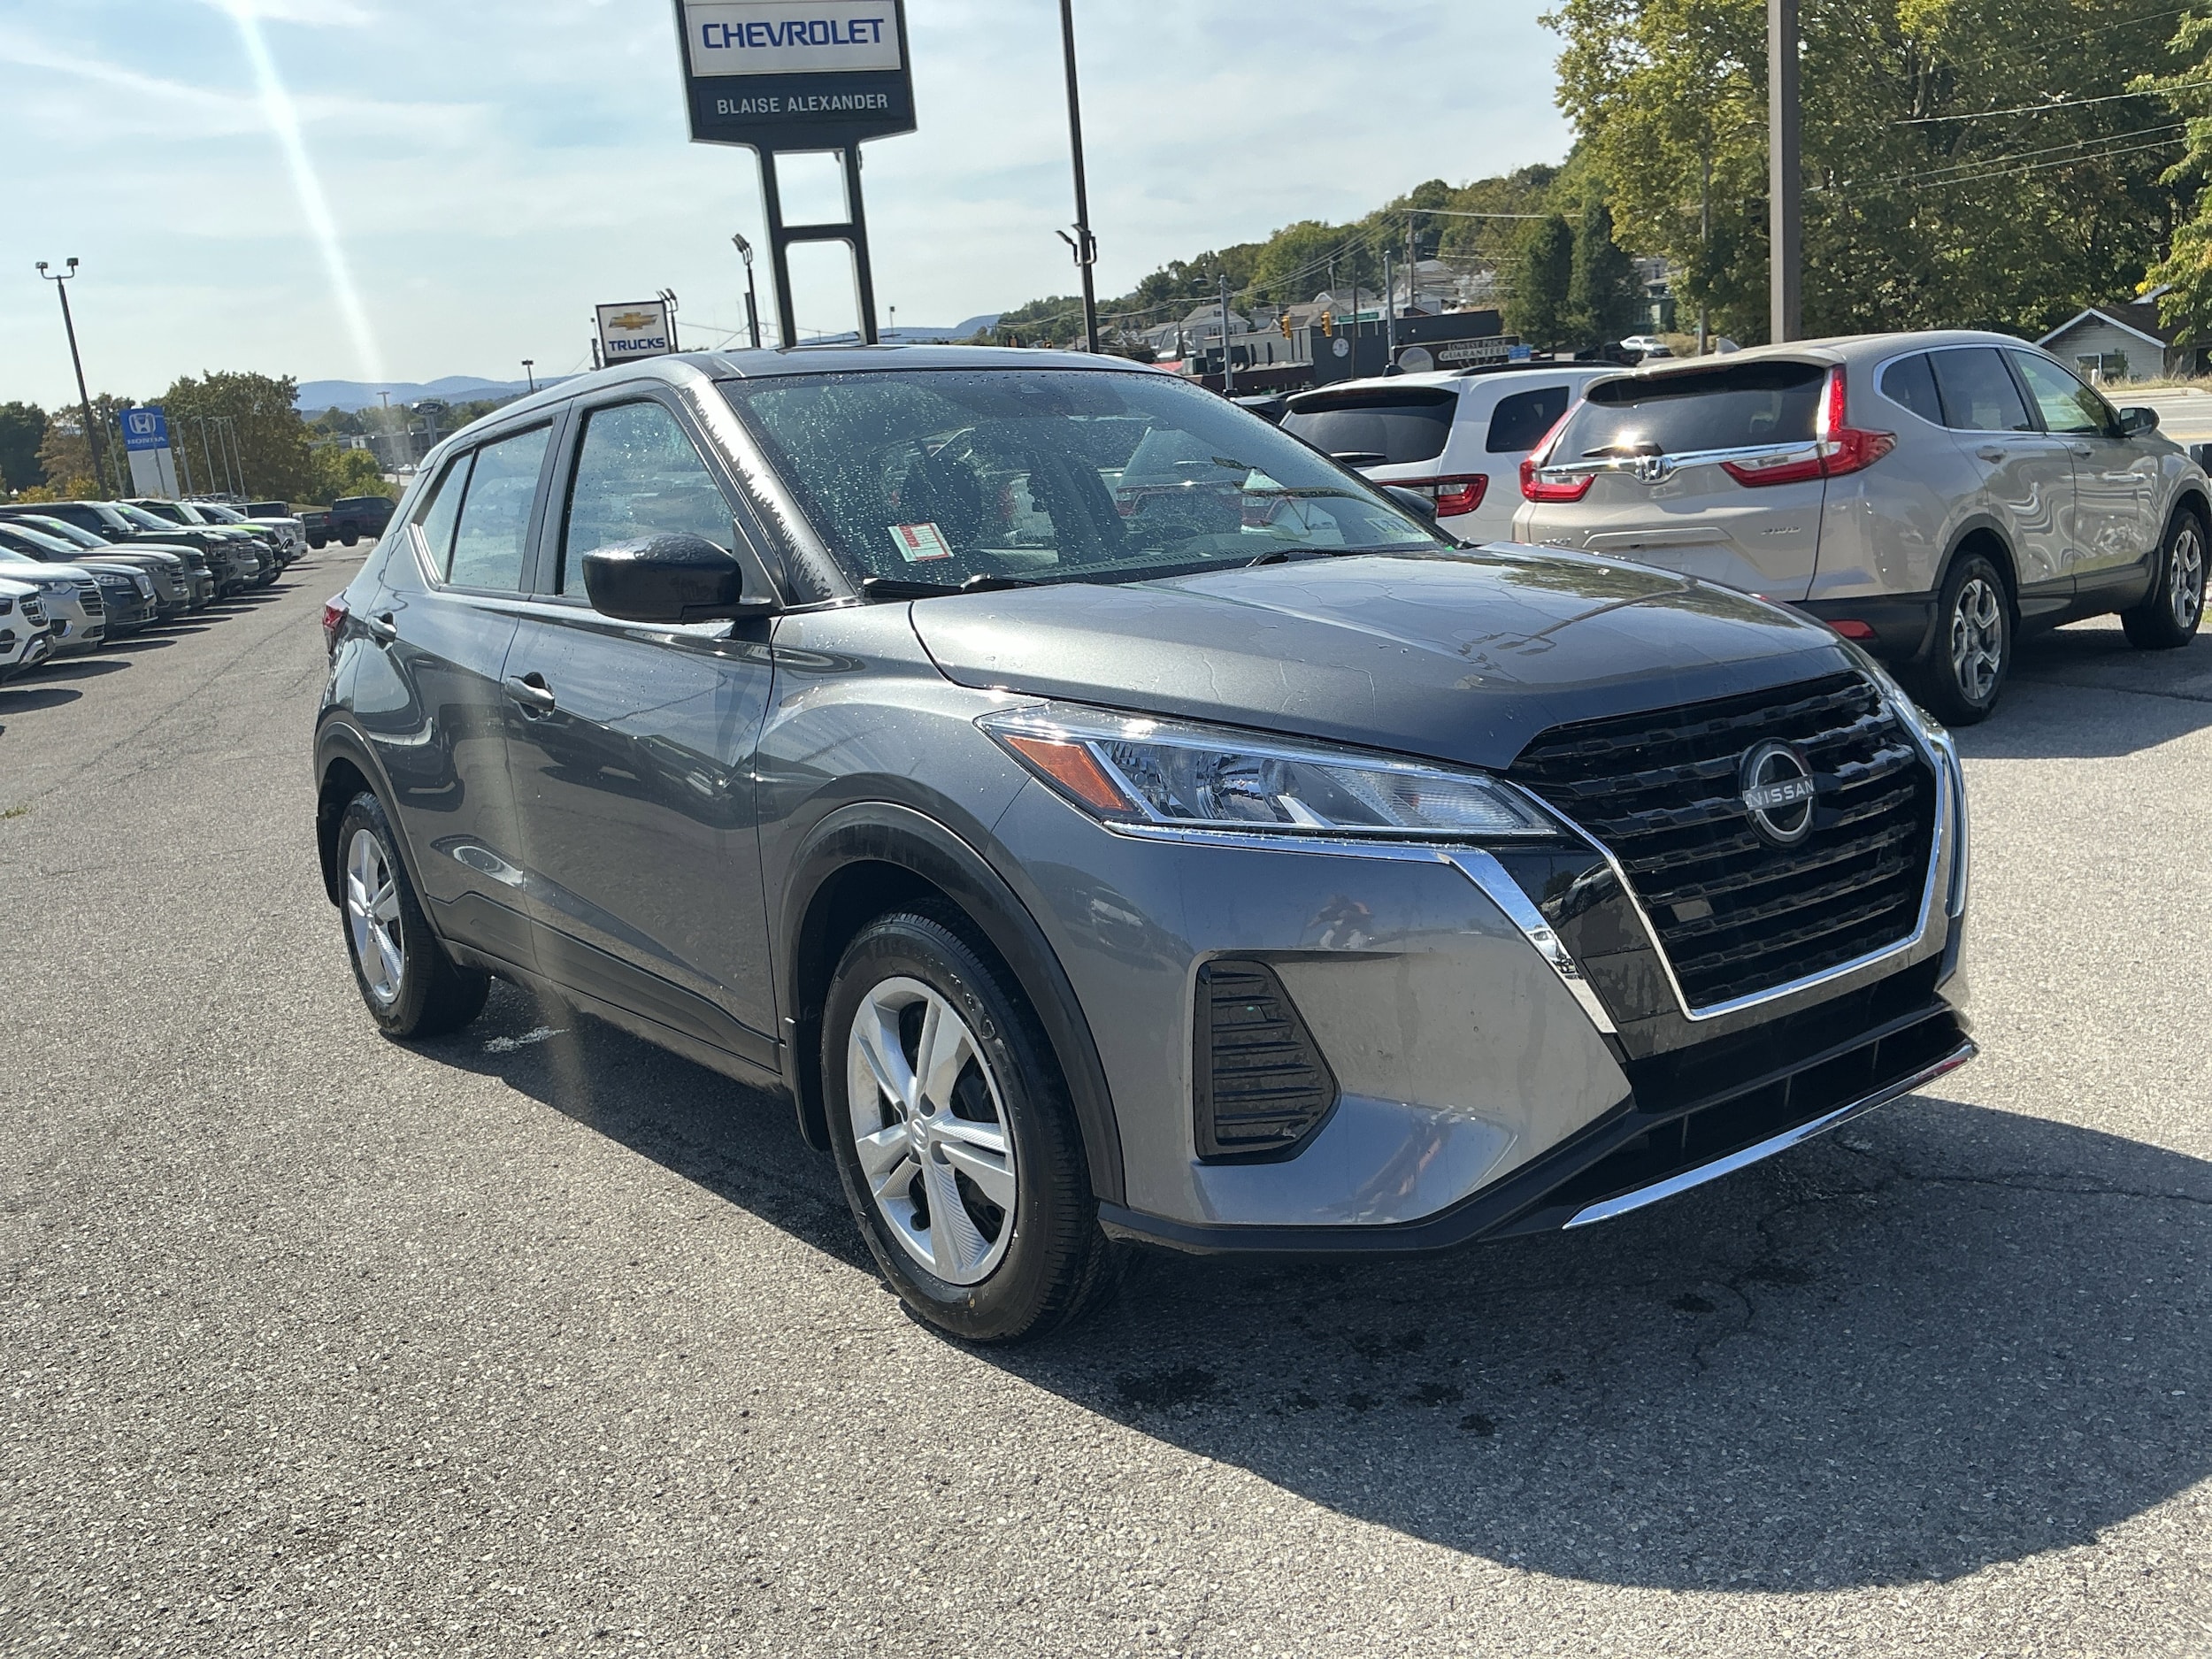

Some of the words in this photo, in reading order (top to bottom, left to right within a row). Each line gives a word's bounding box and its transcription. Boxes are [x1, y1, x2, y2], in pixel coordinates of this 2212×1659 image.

[703, 19, 883, 49] CHEVROLET
[717, 97, 780, 115] BLAISE
[787, 93, 888, 112] ALEXANDER
[609, 337, 665, 351] TRUCKS
[1441, 347, 1508, 359] GUARANTEED
[419, 404, 439, 414] Ford
[1746, 779, 1815, 806] NISSAN
